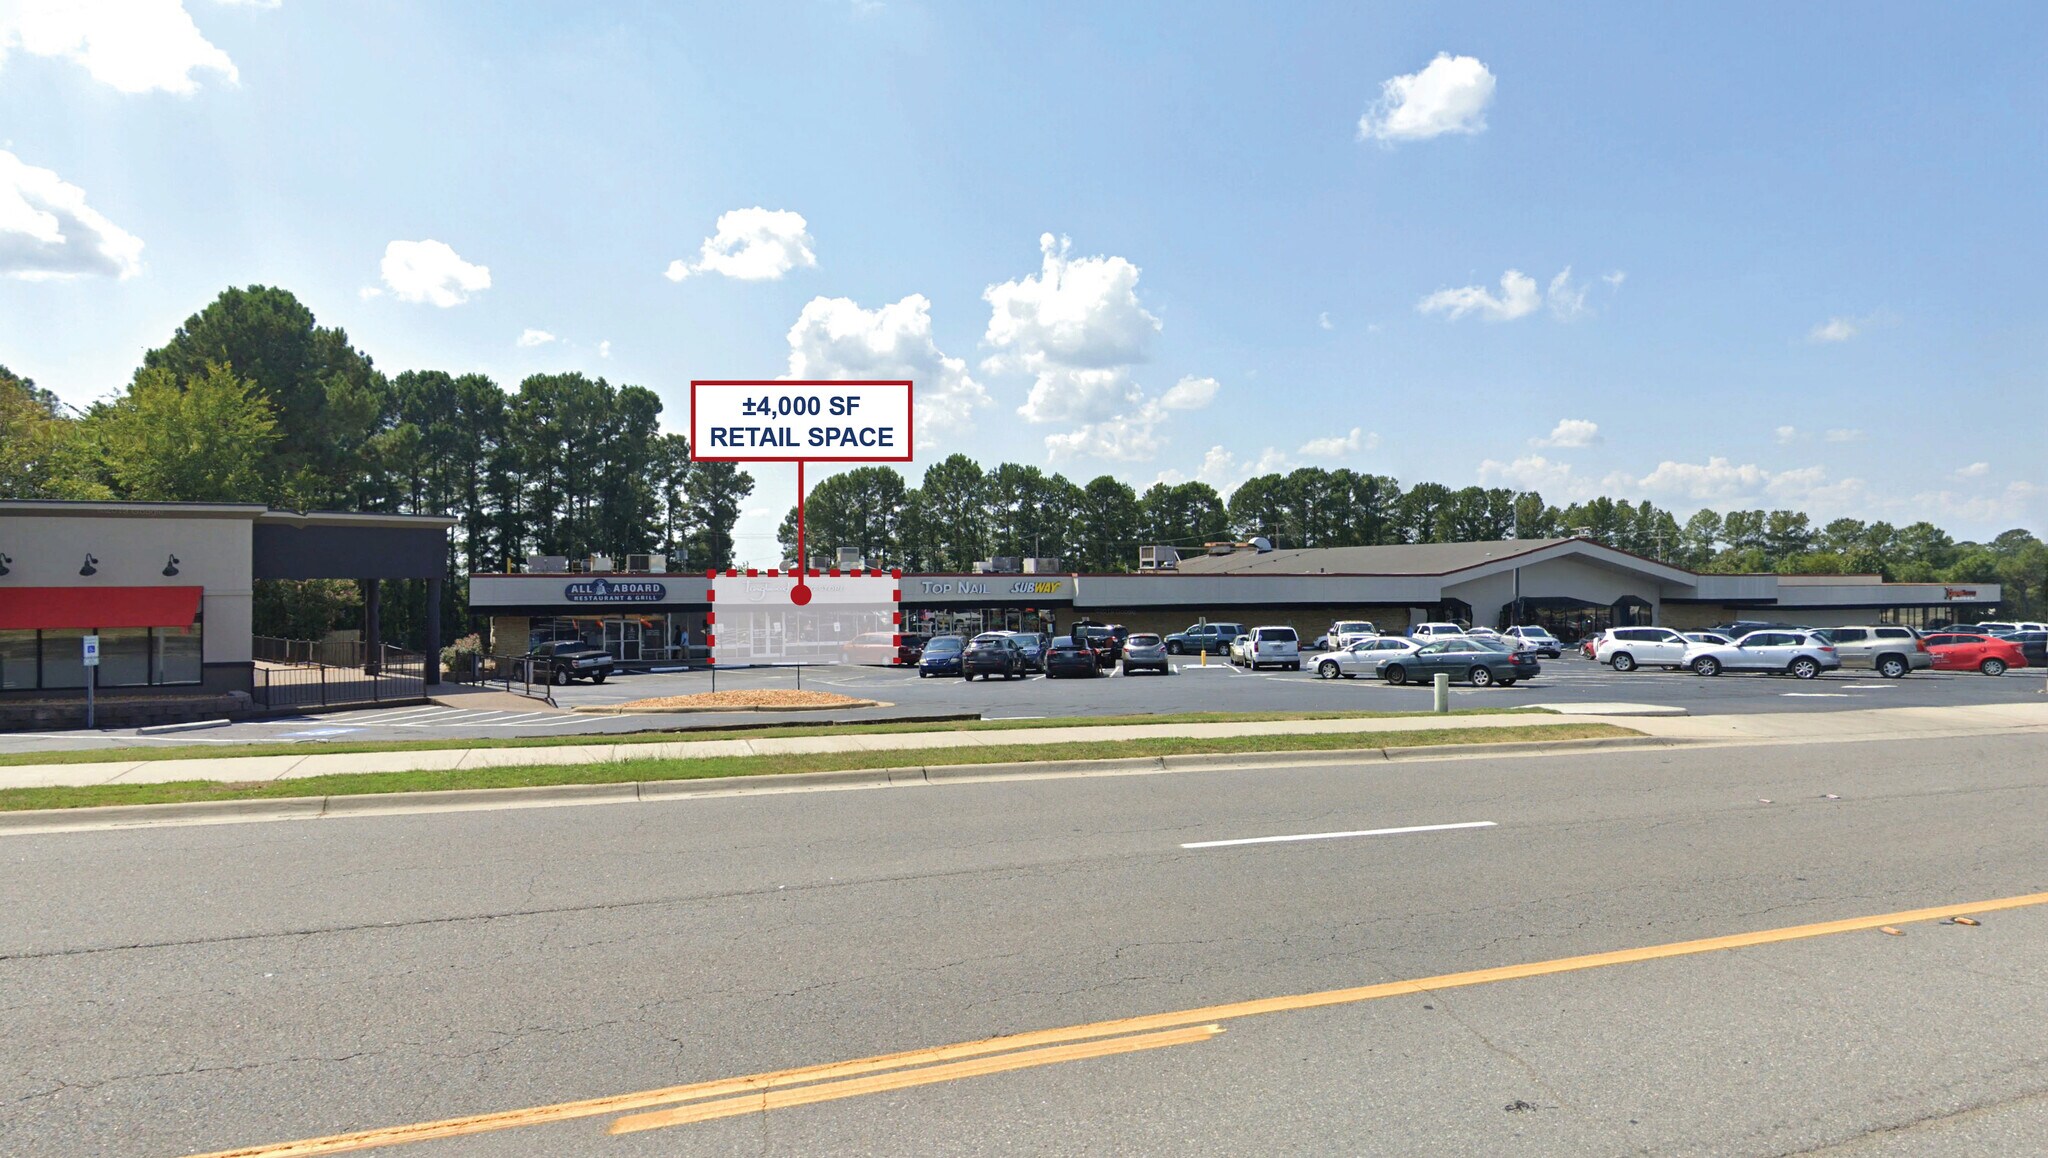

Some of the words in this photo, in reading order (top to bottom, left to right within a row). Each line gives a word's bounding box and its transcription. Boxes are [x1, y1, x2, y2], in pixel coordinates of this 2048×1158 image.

[571, 584, 593, 593] ALL
[613, 583, 660, 593] ABOARD
[921, 581, 952, 594] TOP
[957, 581, 991, 594] NAIL
[1010, 581, 1061, 594] SUBWAY
